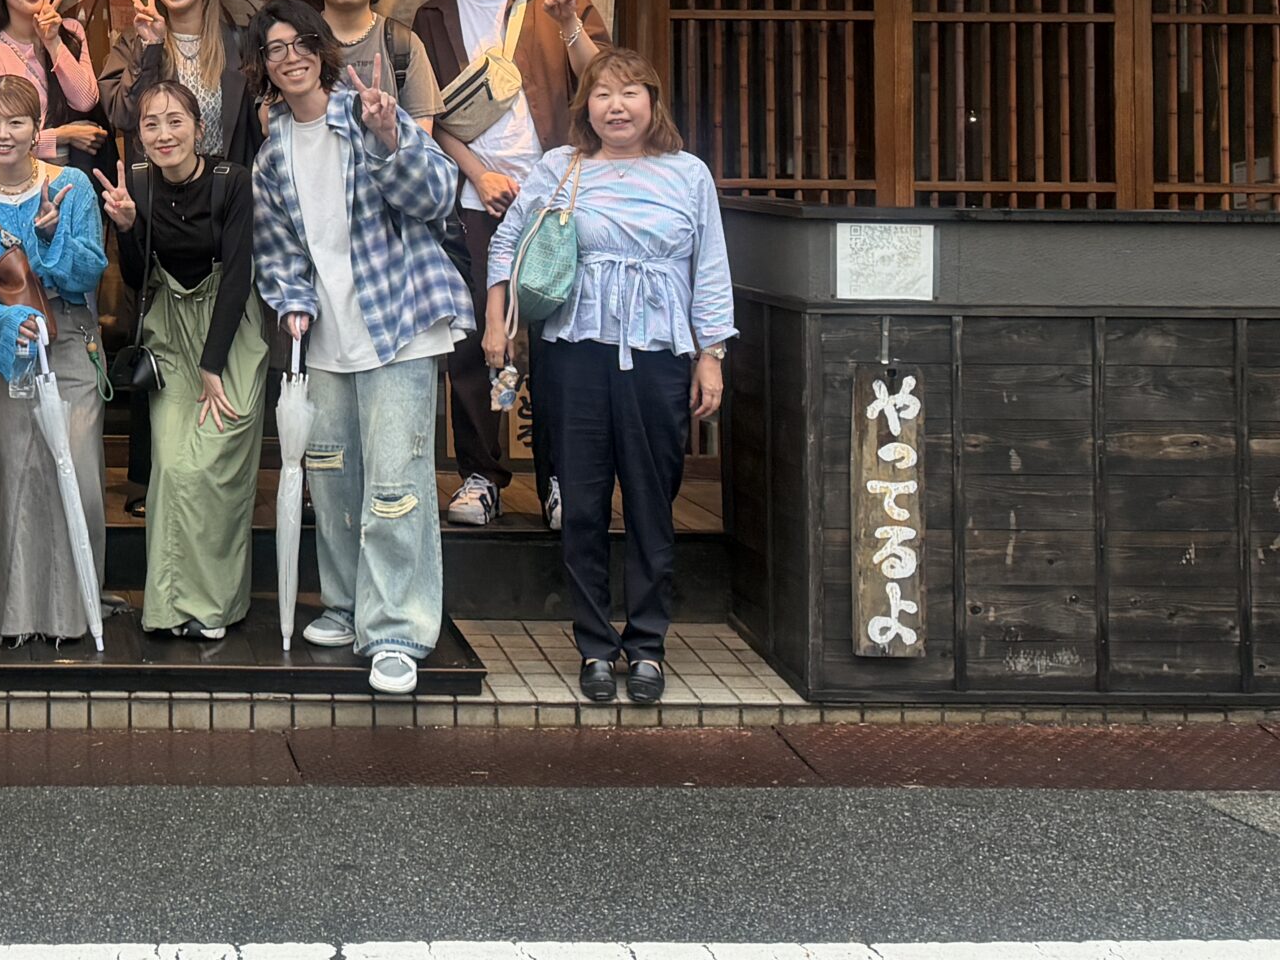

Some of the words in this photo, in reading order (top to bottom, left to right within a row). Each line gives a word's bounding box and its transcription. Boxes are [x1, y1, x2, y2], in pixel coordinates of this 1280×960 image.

[866, 375, 921, 646] やってるよ
